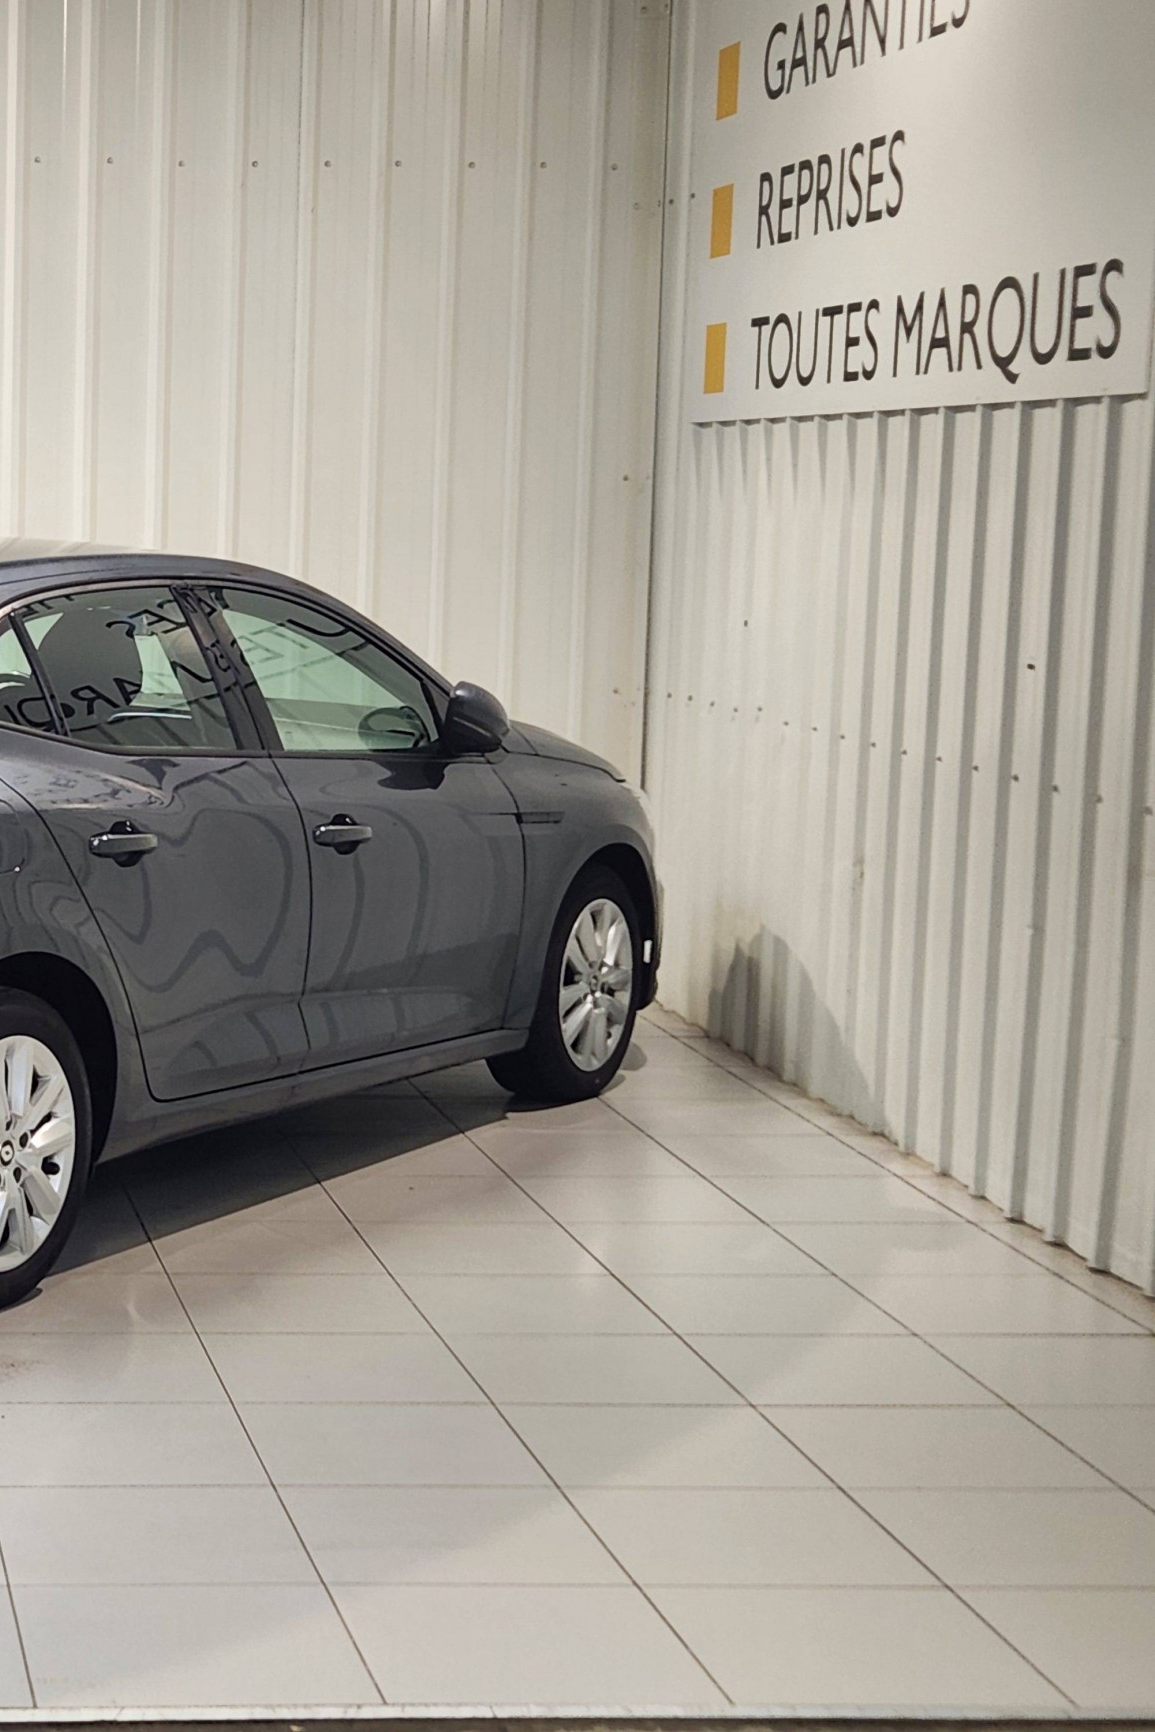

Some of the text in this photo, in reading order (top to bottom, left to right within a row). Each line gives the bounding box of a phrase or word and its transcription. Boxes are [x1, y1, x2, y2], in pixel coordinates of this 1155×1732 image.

[756, 130, 906, 249] REPRISES
[750, 258, 1124, 390] TOUTES MARQUES
